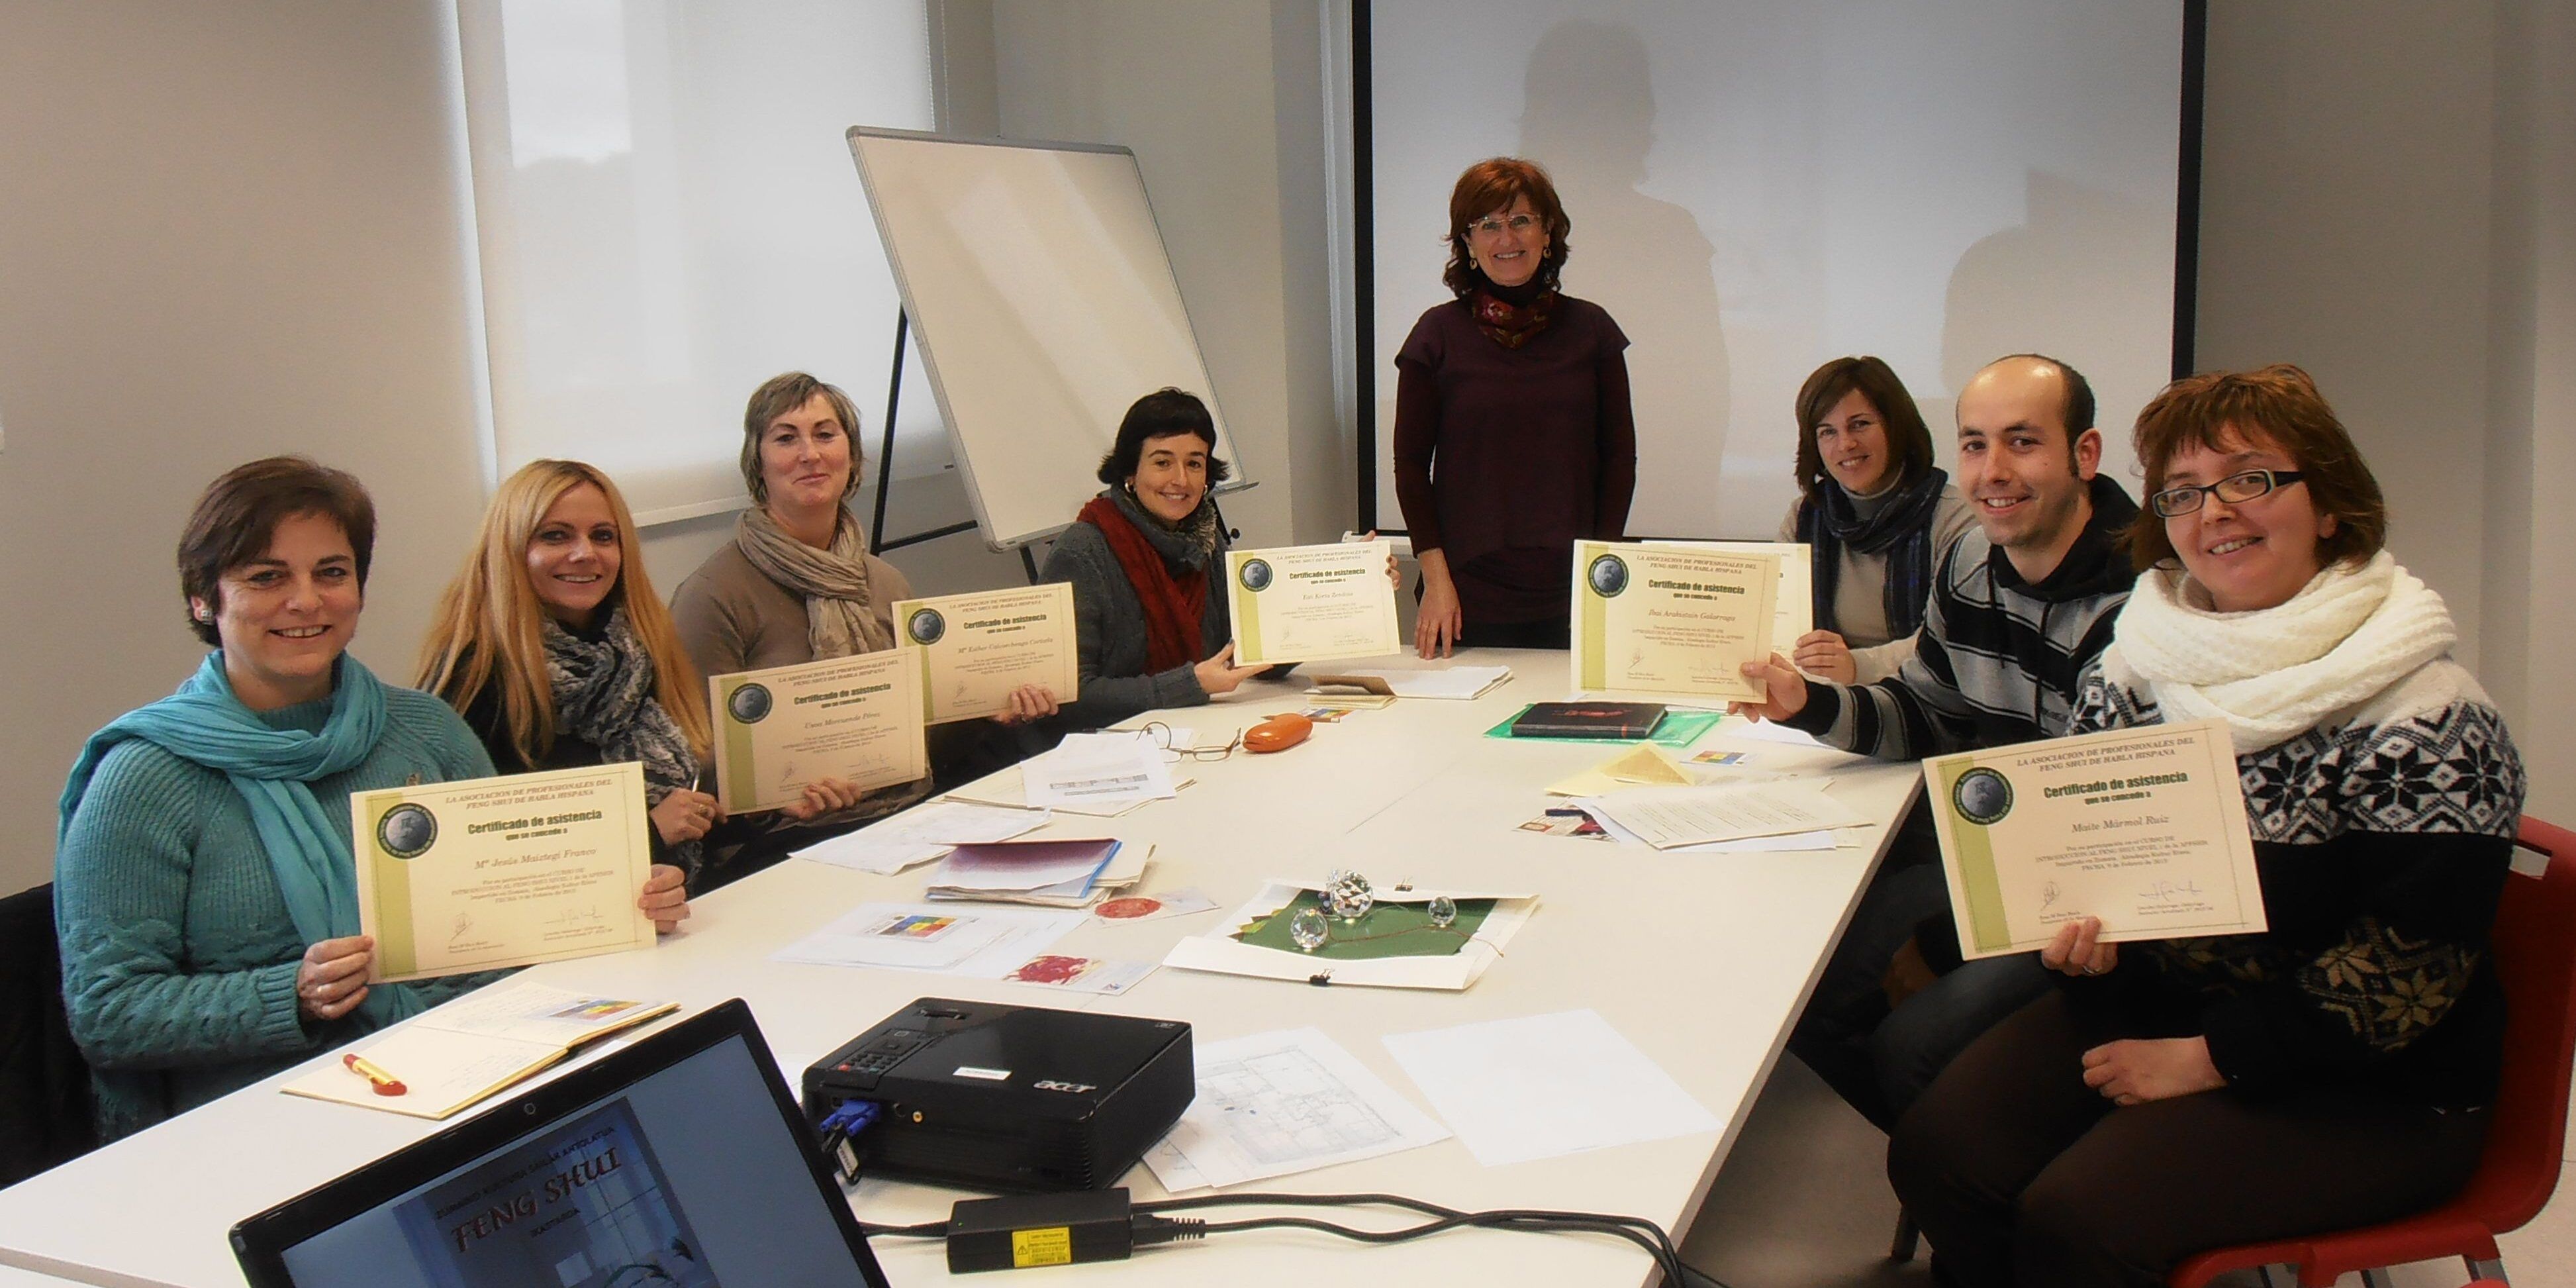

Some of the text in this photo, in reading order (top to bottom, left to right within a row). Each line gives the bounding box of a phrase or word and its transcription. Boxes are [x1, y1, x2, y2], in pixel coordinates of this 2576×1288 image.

[1290, 571, 1323, 579] Certificado
[1334, 568, 1365, 576] asistencia
[1648, 579, 1744, 594] Certificado de asistencia
[964, 619, 1001, 629] Certificado
[1012, 614, 1047, 623] asistencia
[794, 691, 837, 705] Certificado
[851, 683, 890, 695] asistencia
[2031, 752, 2084, 765] ASOCIACION
[2101, 740, 2174, 756] PROFESIONALES
[2177, 737, 2195, 746] DEL
[2040, 763, 2064, 772] FENG
[2066, 760, 2087, 769] SHUI
[2104, 754, 2133, 764] HABLA
[2136, 748, 2175, 760] HISPANA
[459, 791, 509, 802] ASOCIACION
[526, 781, 594, 795] PROFESIONALES
[2044, 771, 2188, 799] Certificado de asistencia
[528, 794, 555, 803] HABLA
[557, 789, 594, 799] HISPANA
[2085, 797, 2099, 805] que
[2112, 791, 2144, 801] concede
[468, 809, 602, 834] Certificado de asistencia
[2146, 815, 2170, 825] Ruiz
[563, 848, 596, 858] Franco
[1033, 1080, 1097, 1093] acer
[451, 1189, 538, 1252] FENG
[544, 1146, 622, 1204] SHUI
